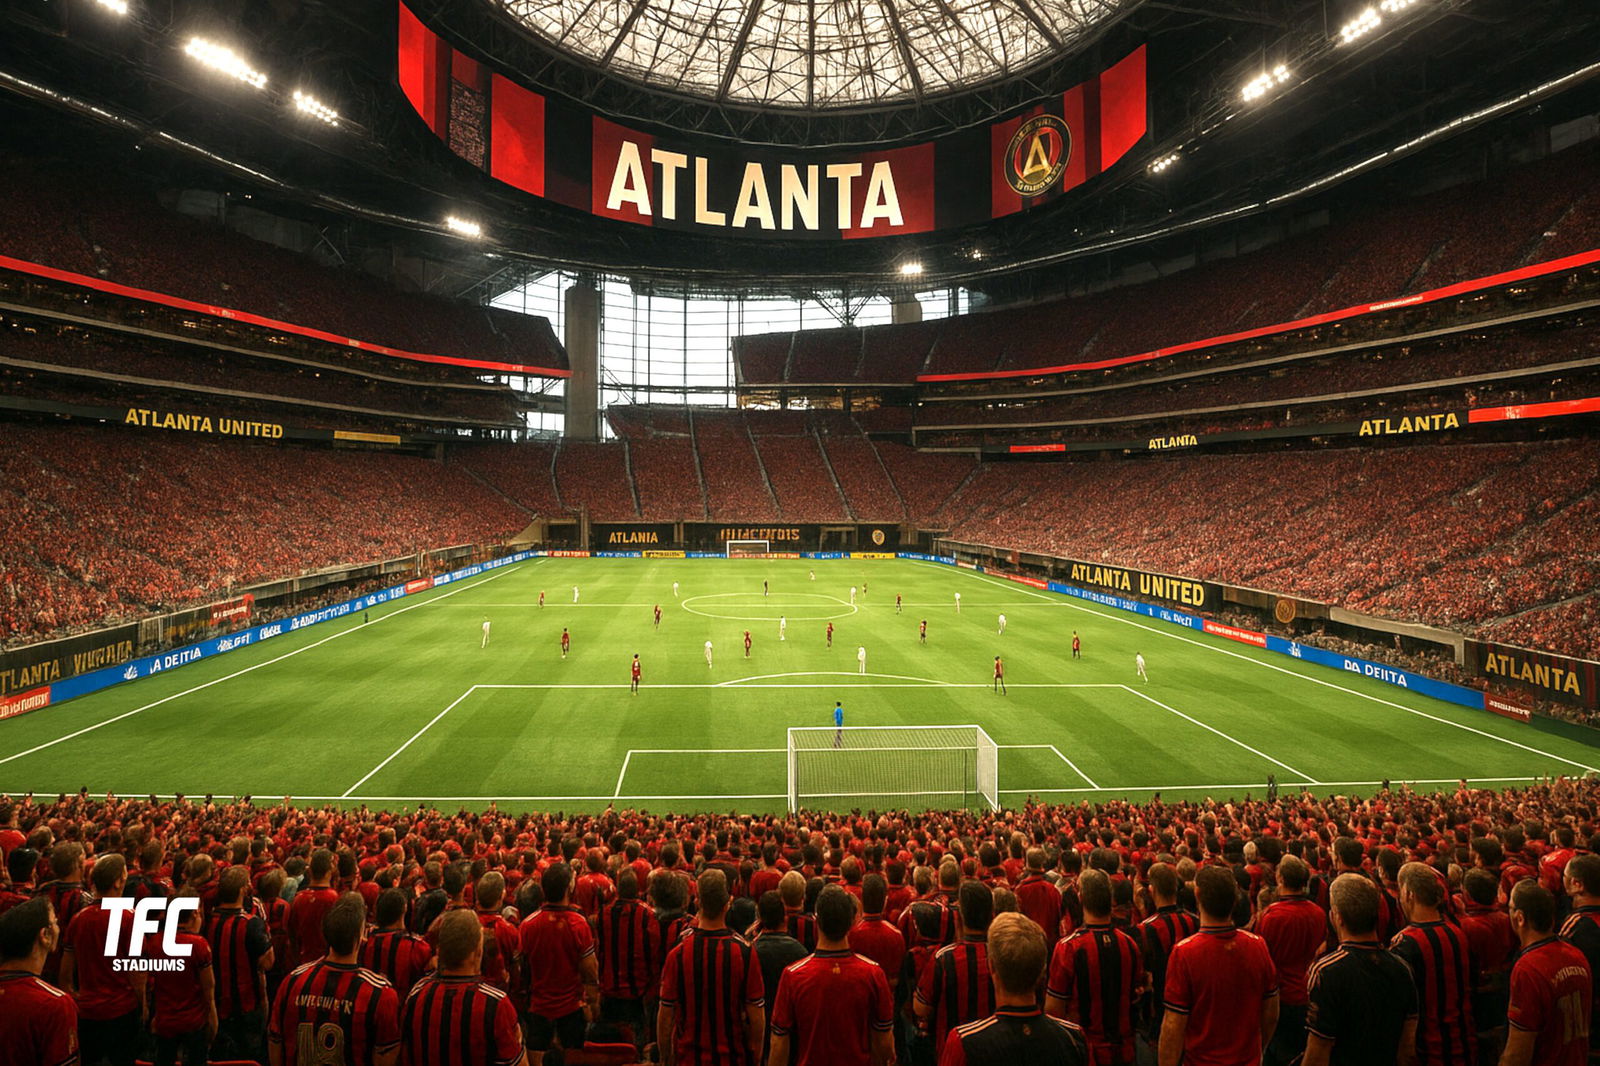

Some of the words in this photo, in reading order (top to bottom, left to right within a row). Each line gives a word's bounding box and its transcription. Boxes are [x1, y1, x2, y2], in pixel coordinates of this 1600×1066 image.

[606, 140, 905, 231] ATLANTA
[125, 408, 213, 433] ATLANTA
[219, 417, 283, 439] UNITED
[1148, 434, 1198, 449] ATLANTA
[1359, 412, 1460, 436] ATLANTA
[1071, 563, 1131, 591] ATLANTA
[1140, 574, 1205, 606] UNITED
[1485, 652, 1581, 696] ATLANTA
